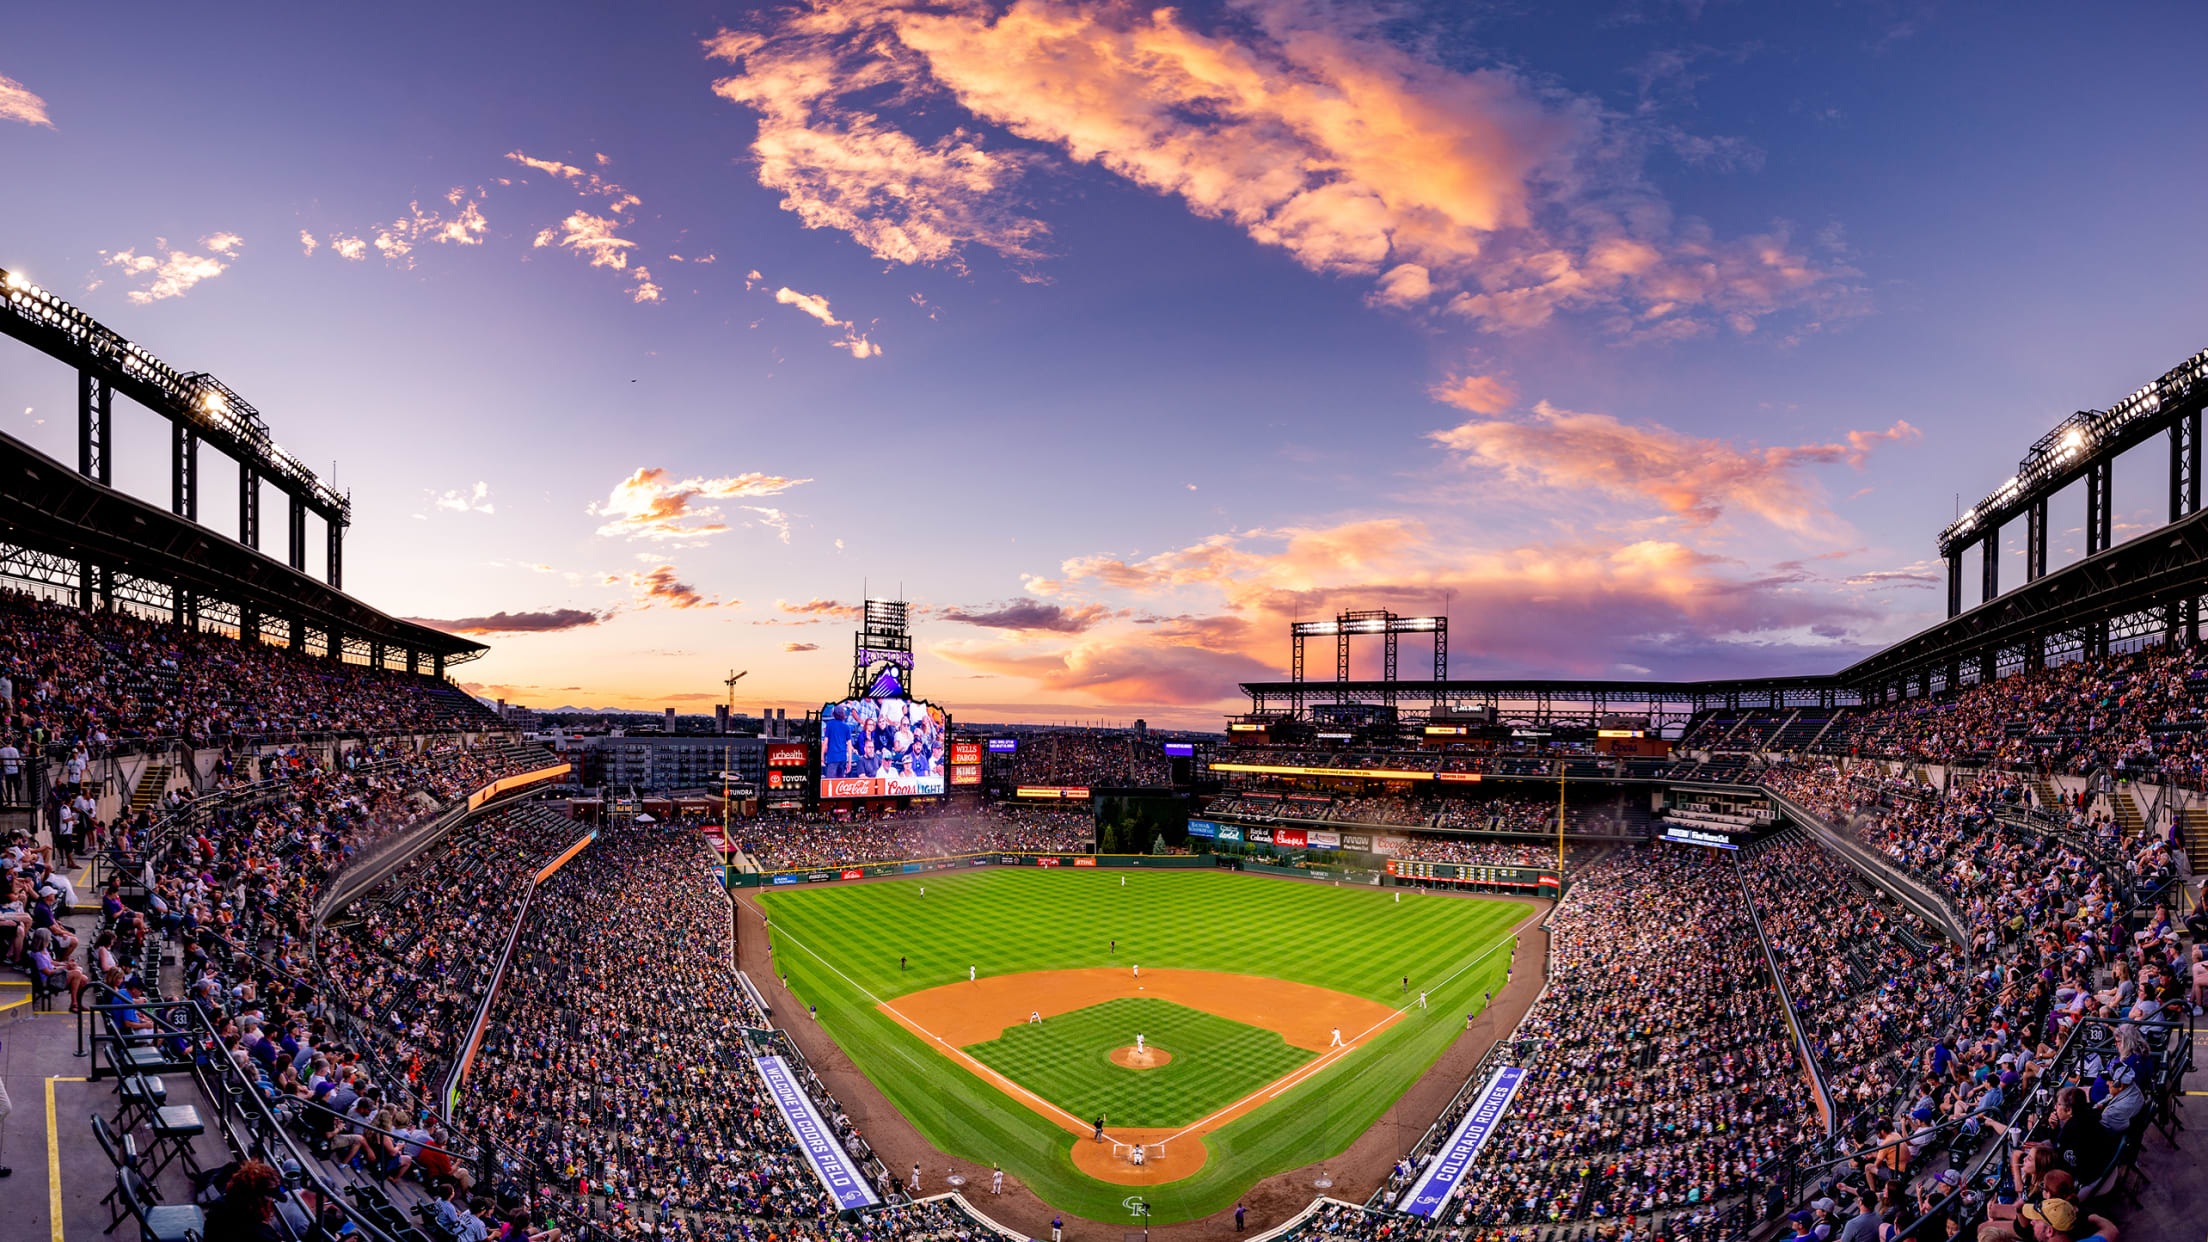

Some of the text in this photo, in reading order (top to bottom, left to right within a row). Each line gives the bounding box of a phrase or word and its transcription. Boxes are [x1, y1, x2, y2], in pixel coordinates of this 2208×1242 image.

[956, 745, 977, 753] WELLS
[772, 749, 803, 760] uchealth
[956, 754, 977, 762] FARGO
[956, 766, 977, 776] KING
[888, 780, 941, 795] Coors LIGHT
[1250, 834, 1274, 843] Colorado
[174, 1015, 187, 1025] 331
[2090, 1030, 2103, 1041] 330
[766, 1067, 851, 1187] WELCOME TO COORS FIELD
[1436, 1086, 1509, 1182] COLORADO ROCKIES
